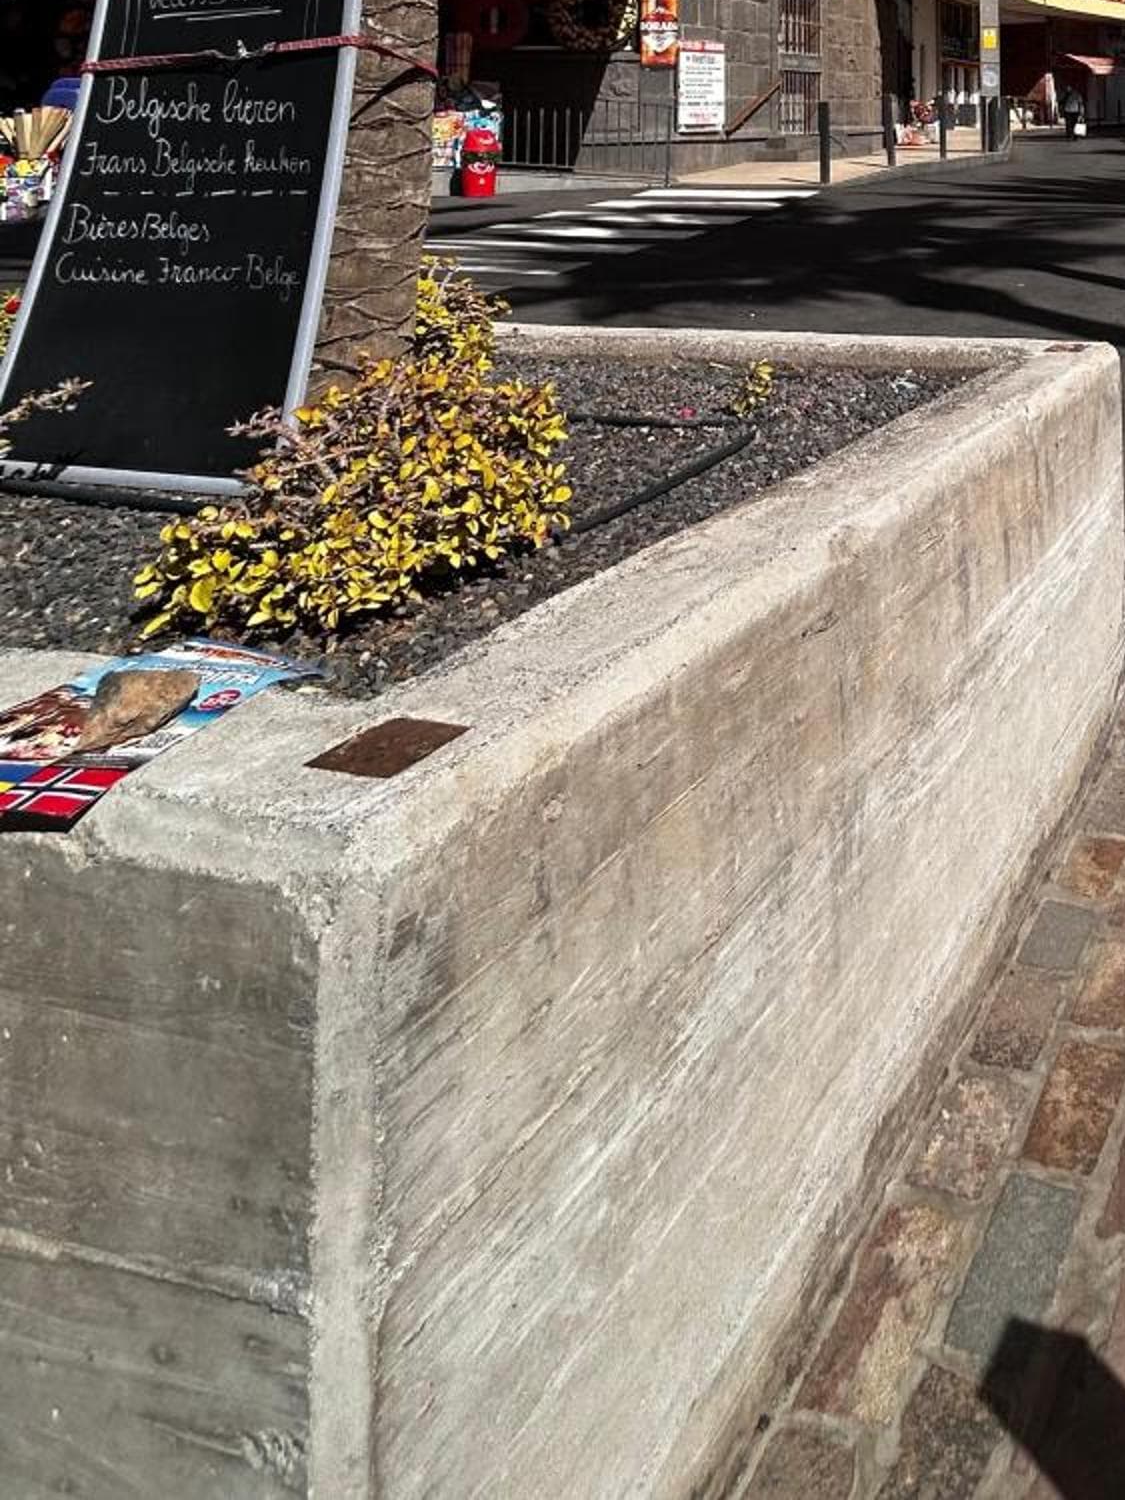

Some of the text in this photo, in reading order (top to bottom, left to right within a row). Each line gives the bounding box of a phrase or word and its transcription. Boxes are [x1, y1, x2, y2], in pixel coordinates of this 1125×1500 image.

[96, 76, 212, 138] Belgische
[80, 141, 148, 176] Frans
[151, 138, 237, 189] Belgische
[55, 252, 149, 285] Cuisine
